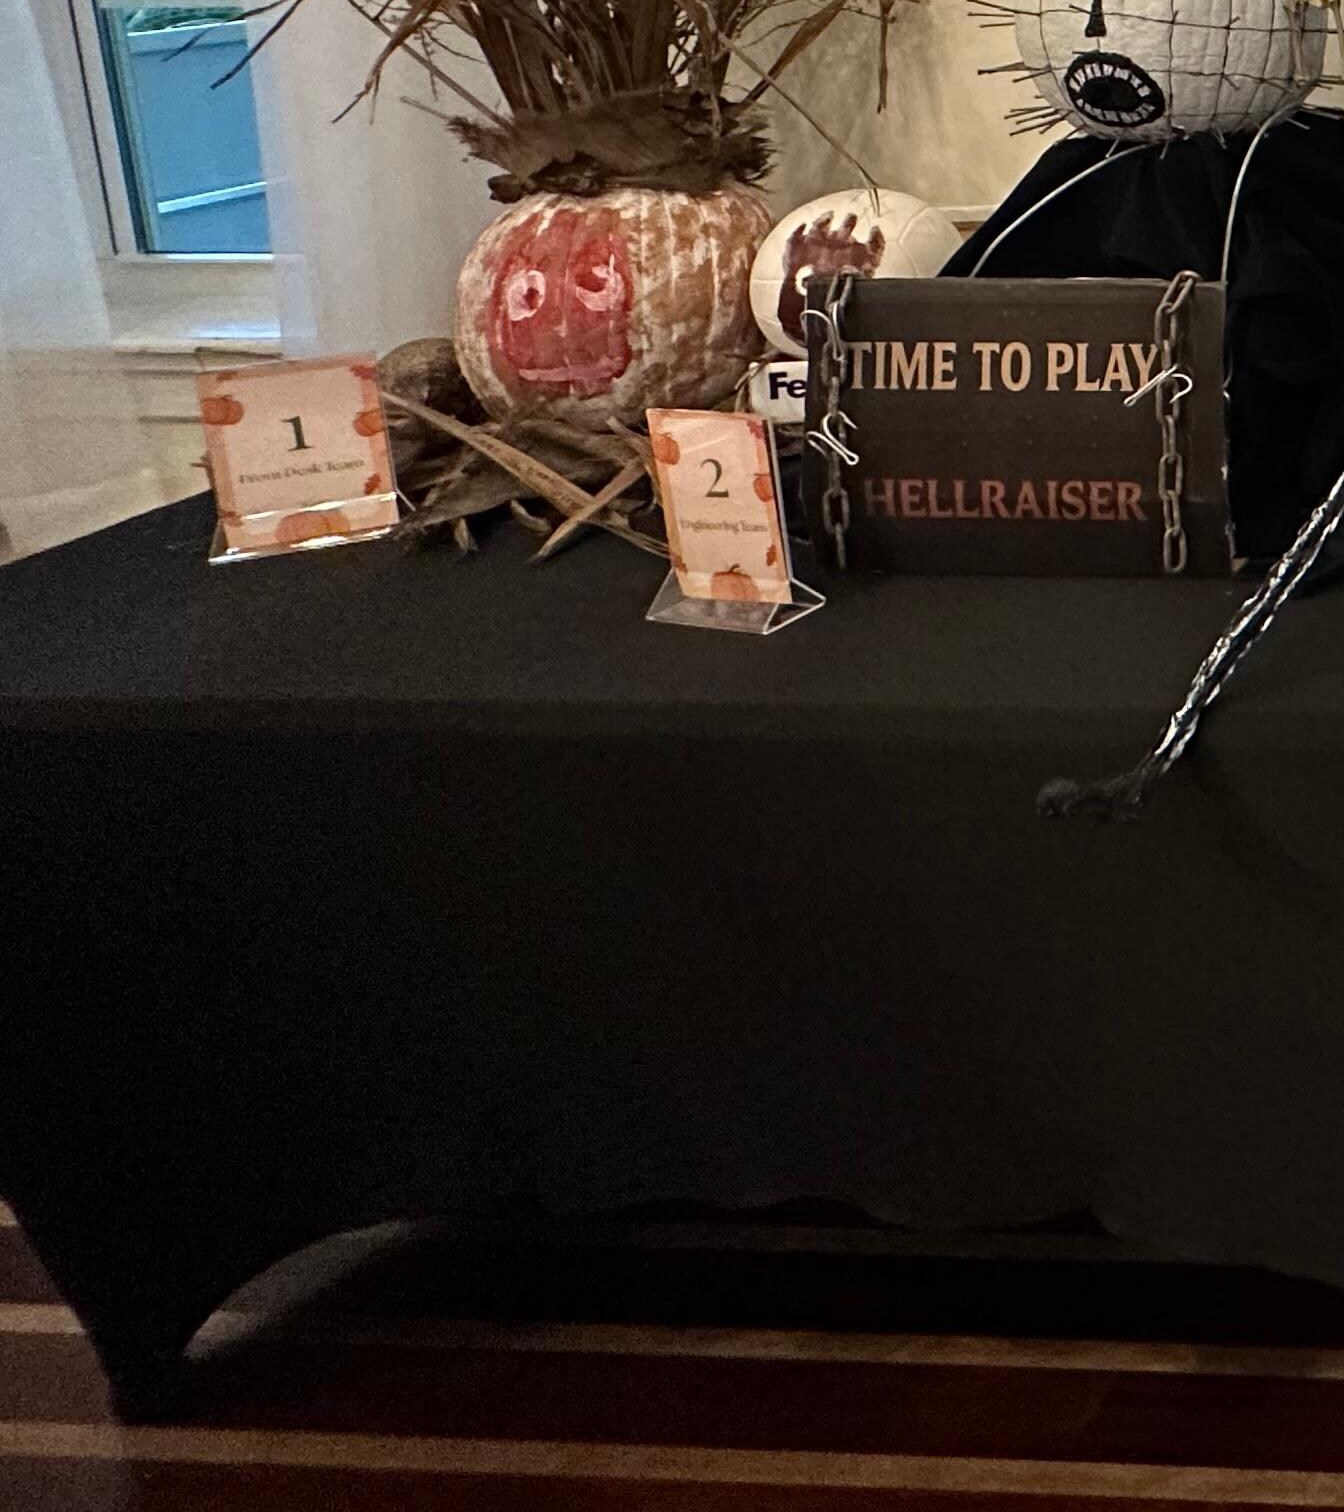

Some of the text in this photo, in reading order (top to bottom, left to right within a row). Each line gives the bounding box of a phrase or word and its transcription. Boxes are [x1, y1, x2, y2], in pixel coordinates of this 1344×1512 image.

[848, 341, 1159, 392] TIME TO PLAY
[280, 415, 314, 452] 1
[239, 459, 365, 485] Front Desk Team
[700, 458, 730, 498] 2
[863, 478, 1147, 521] HELLRAISER
[679, 519, 769, 535] Engineering Team
